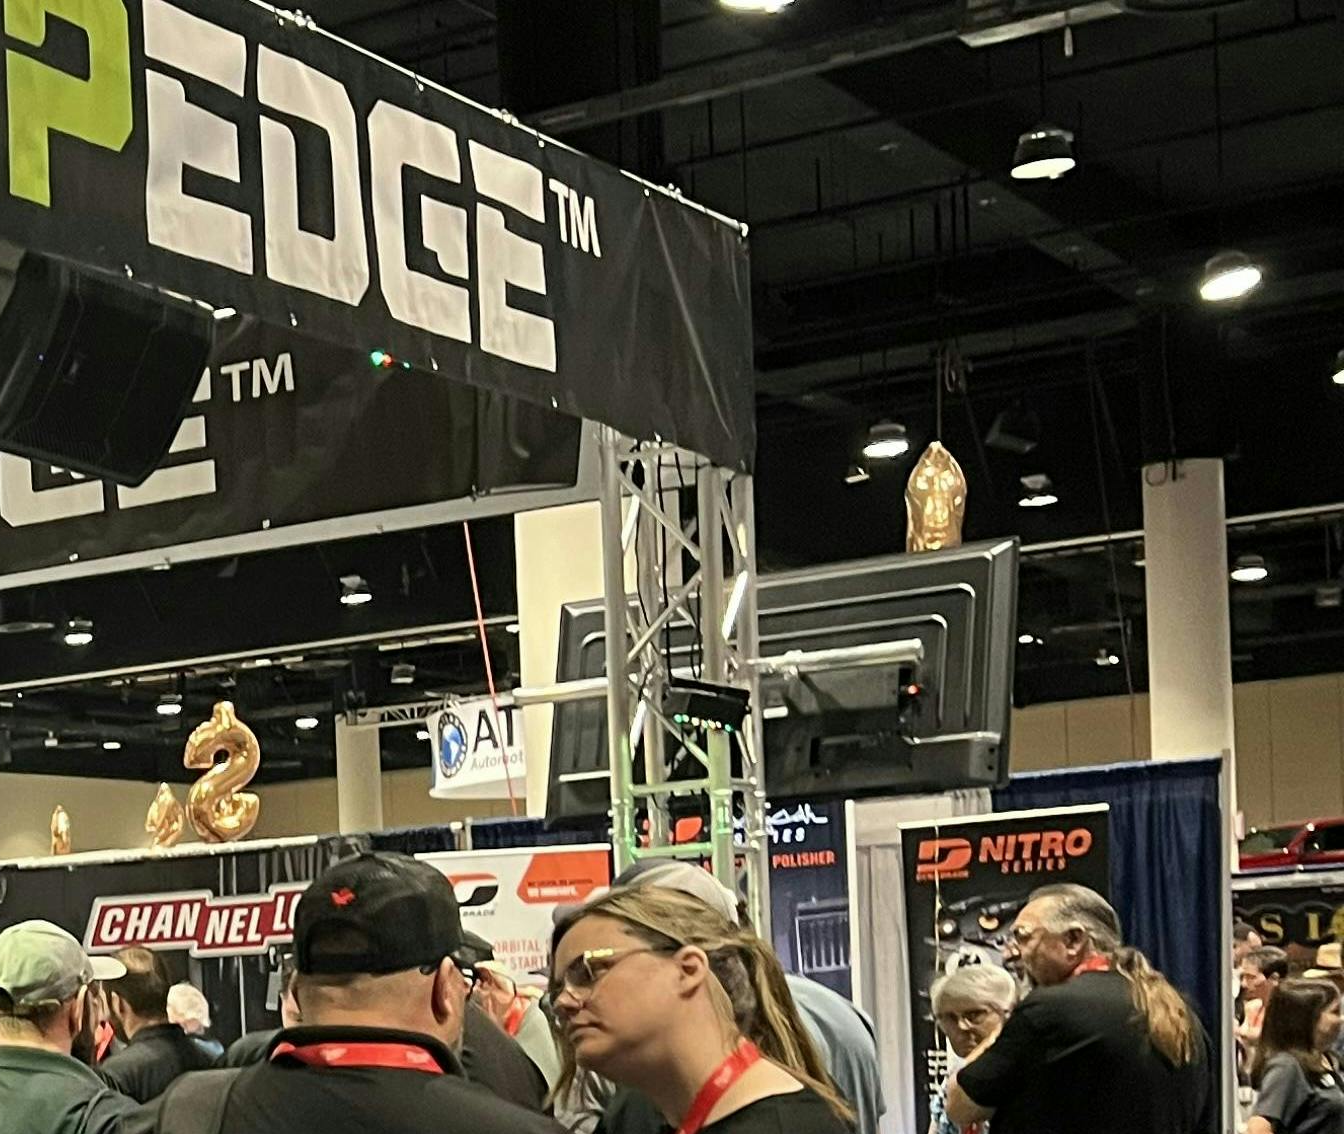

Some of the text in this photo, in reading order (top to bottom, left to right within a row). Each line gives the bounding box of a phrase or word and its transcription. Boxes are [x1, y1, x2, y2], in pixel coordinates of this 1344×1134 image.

[978, 827, 1093, 863] NITRO
[772, 850, 837, 869] POLISHER
[1001, 857, 1067, 875] SERIES
